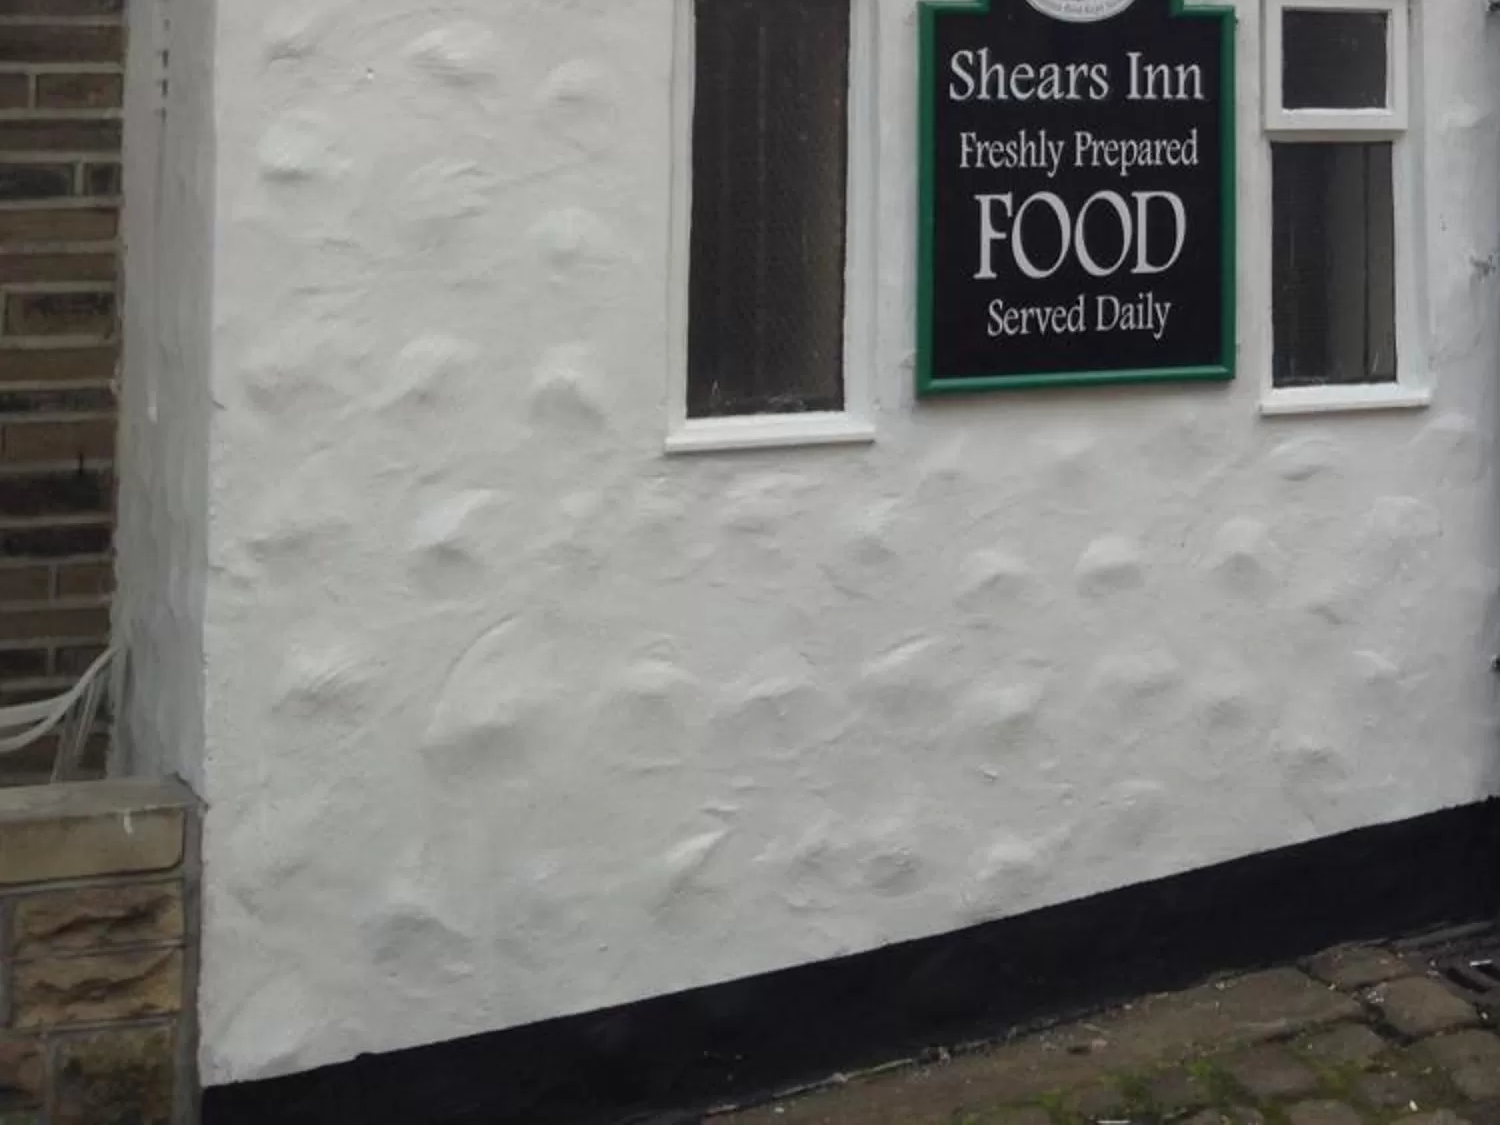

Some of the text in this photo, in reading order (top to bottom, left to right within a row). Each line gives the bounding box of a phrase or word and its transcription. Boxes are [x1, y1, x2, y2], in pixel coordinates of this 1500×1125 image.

[949, 47, 1205, 101] Shears Inn
[959, 127, 1199, 178] Freshly Prepared
[973, 190, 1187, 279] FOOD
[987, 291, 1172, 340] Served Daily
